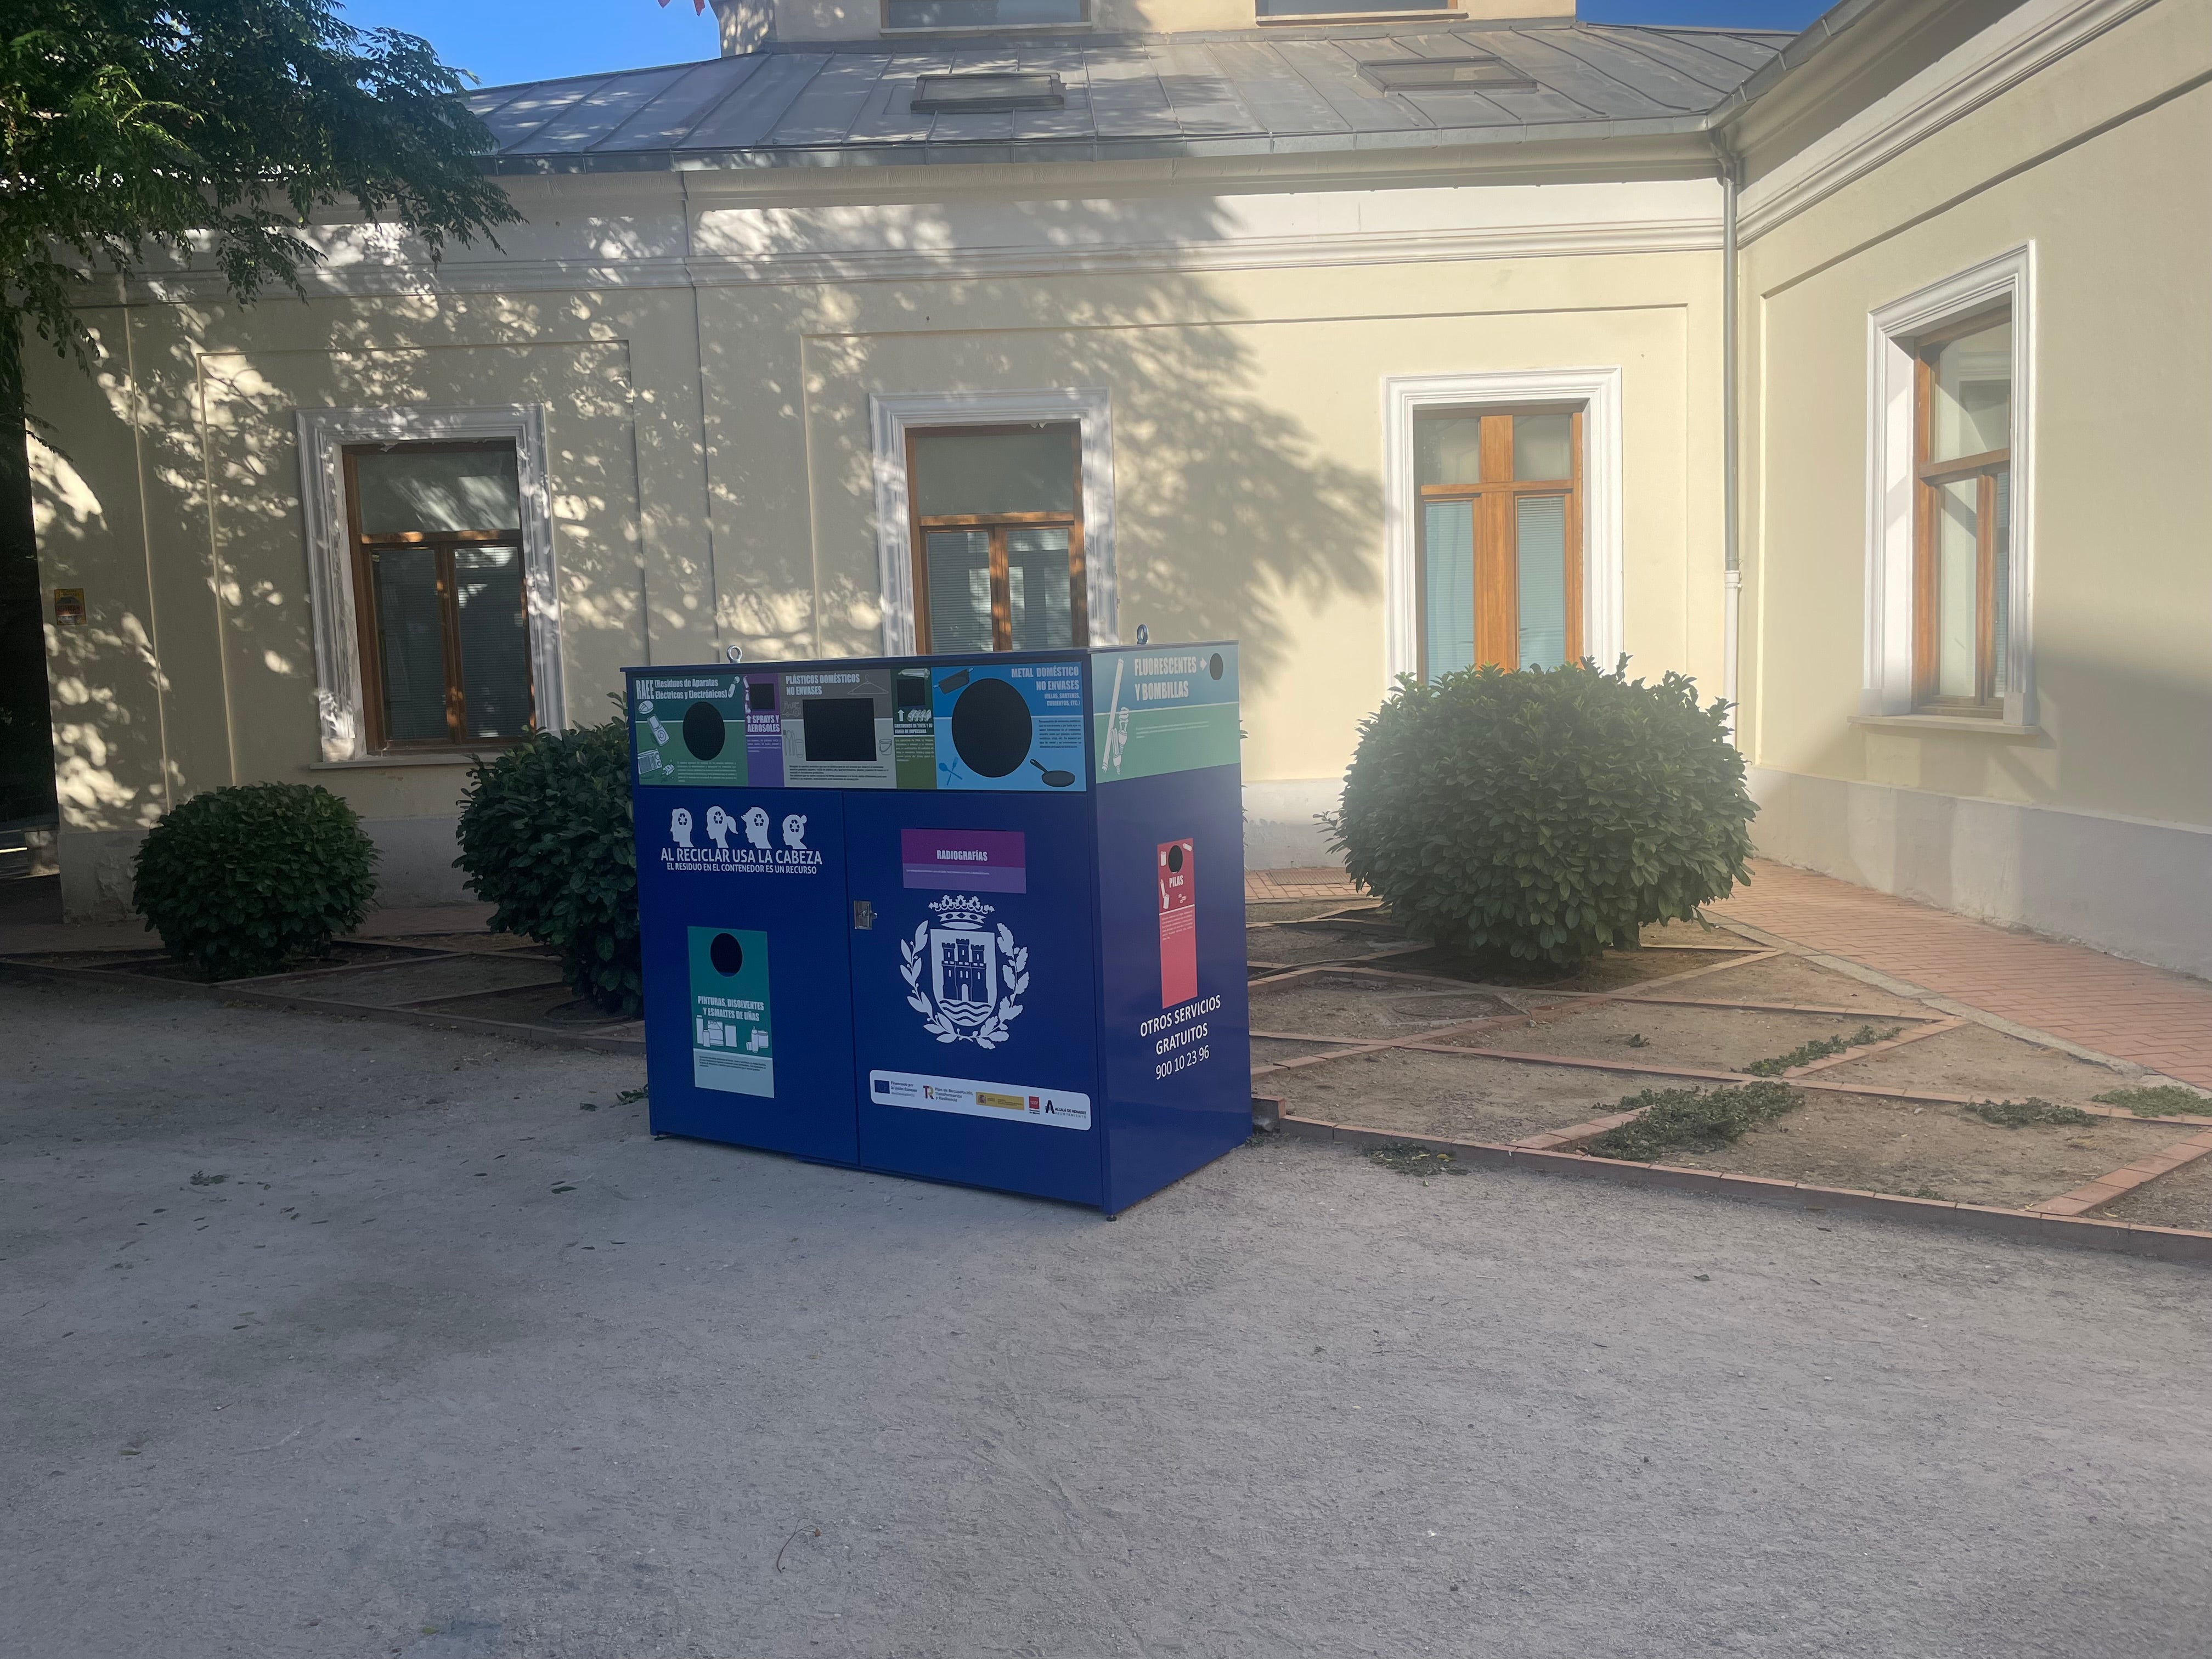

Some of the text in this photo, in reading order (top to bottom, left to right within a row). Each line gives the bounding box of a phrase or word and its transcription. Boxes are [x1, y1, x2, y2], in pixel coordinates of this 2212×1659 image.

[1011, 665, 1079, 678] METAL DOMÉSTICO
[1134, 657, 1197, 676] FLUORESCENTES
[655, 678, 719, 687] (Residuos de Aparatos
[786, 673, 860, 685] PLÁSTICOS DOMÉSTICOS
[1036, 680, 1080, 691] NO ENVASES
[636, 680, 654, 699] RAEE
[656, 690, 684, 699] Eléctricos
[689, 690, 727, 699] Electrónicos)
[786, 686, 822, 696] NO ENVASES
[1135, 680, 1189, 701] Y BOMBILLAS
[752, 715, 780, 724] SPRAYS Y
[747, 724, 780, 732] AEROSOLES
[661, 848, 822, 865] AL RECICLAR USA LA CABEZA
[936, 850, 988, 861] RADIOGRAFÍAS
[675, 862, 702, 871] RESIDUO
[721, 864, 764, 873] CONTENEDOR
[775, 865, 785, 873] UN
[786, 865, 817, 874] RECURSO
[1169, 874, 1183, 888] PILAS
[698, 996, 764, 1011] PINTURAS, DISOLVENTES
[703, 1007, 760, 1021] Y ESMALTES DE UÑAS
[1140, 995, 1221, 1037] OTROS SERVICIOS
[1156, 1023, 1208, 1055] GRATUITOS
[1155, 1045, 1210, 1080] 900 10 23 96
